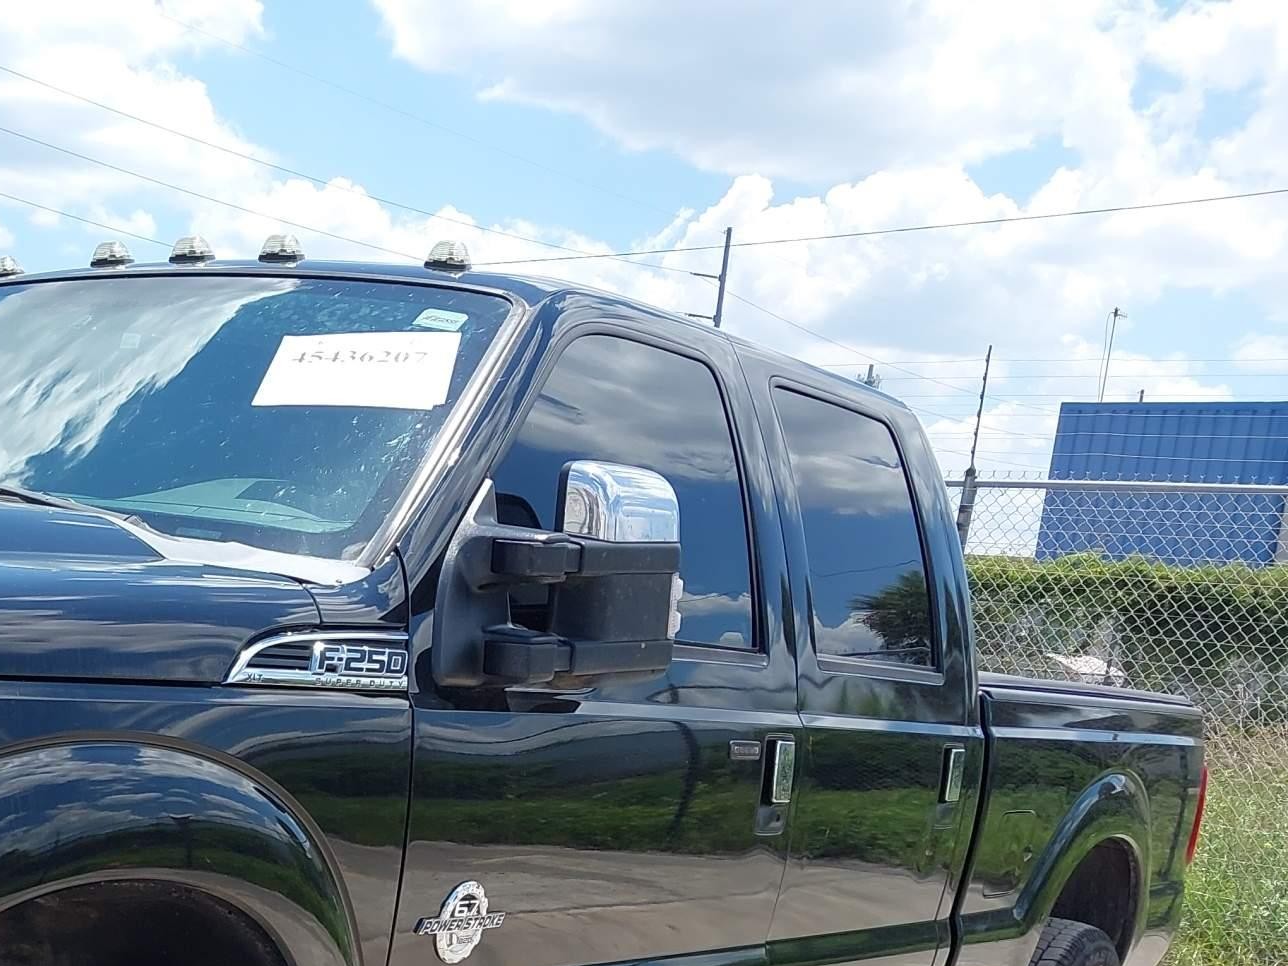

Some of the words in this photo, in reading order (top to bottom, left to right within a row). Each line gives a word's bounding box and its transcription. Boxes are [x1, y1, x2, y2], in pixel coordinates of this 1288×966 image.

[290, 350, 429, 364] 45436207
[246, 673, 263, 682] XLT
[315, 678, 362, 688] SUPER
[369, 680, 405, 689] DUTY
